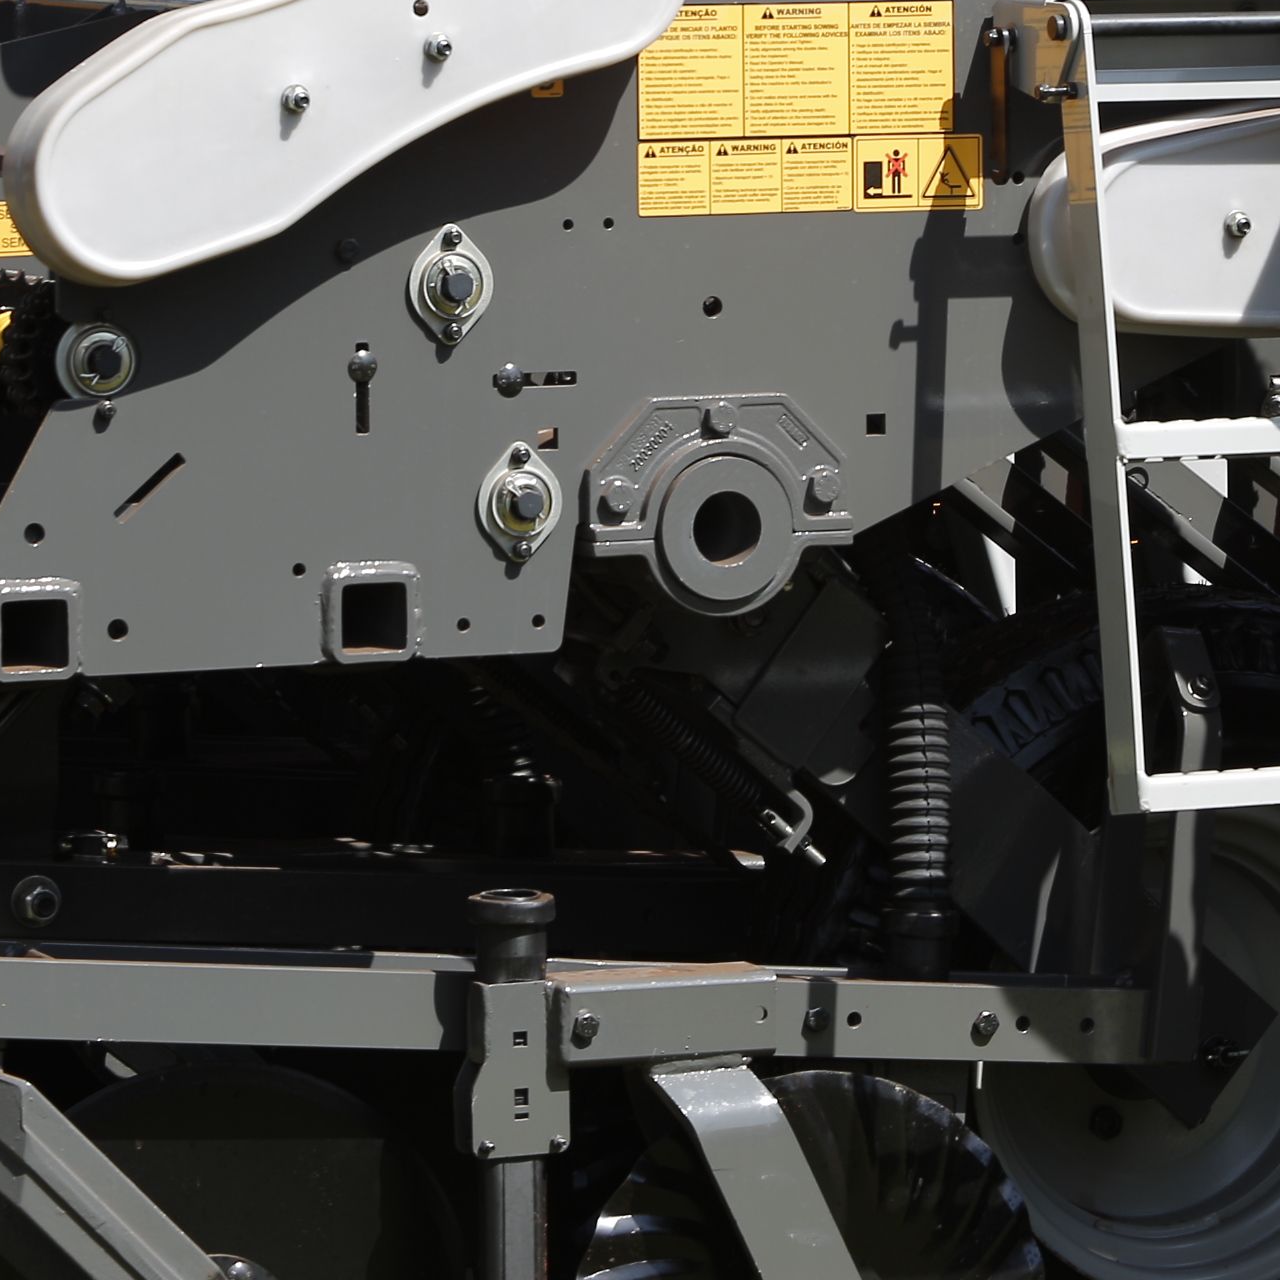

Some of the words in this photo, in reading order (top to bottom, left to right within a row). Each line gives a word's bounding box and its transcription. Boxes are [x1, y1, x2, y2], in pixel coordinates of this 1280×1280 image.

[777, 7, 822, 16] WARNING
[884, 4, 932, 14] ATENCIÓN
[660, 144, 704, 155] ATENÇÃO
[731, 143, 776, 152] WARNING
[801, 140, 848, 150] ATENCIÓN
